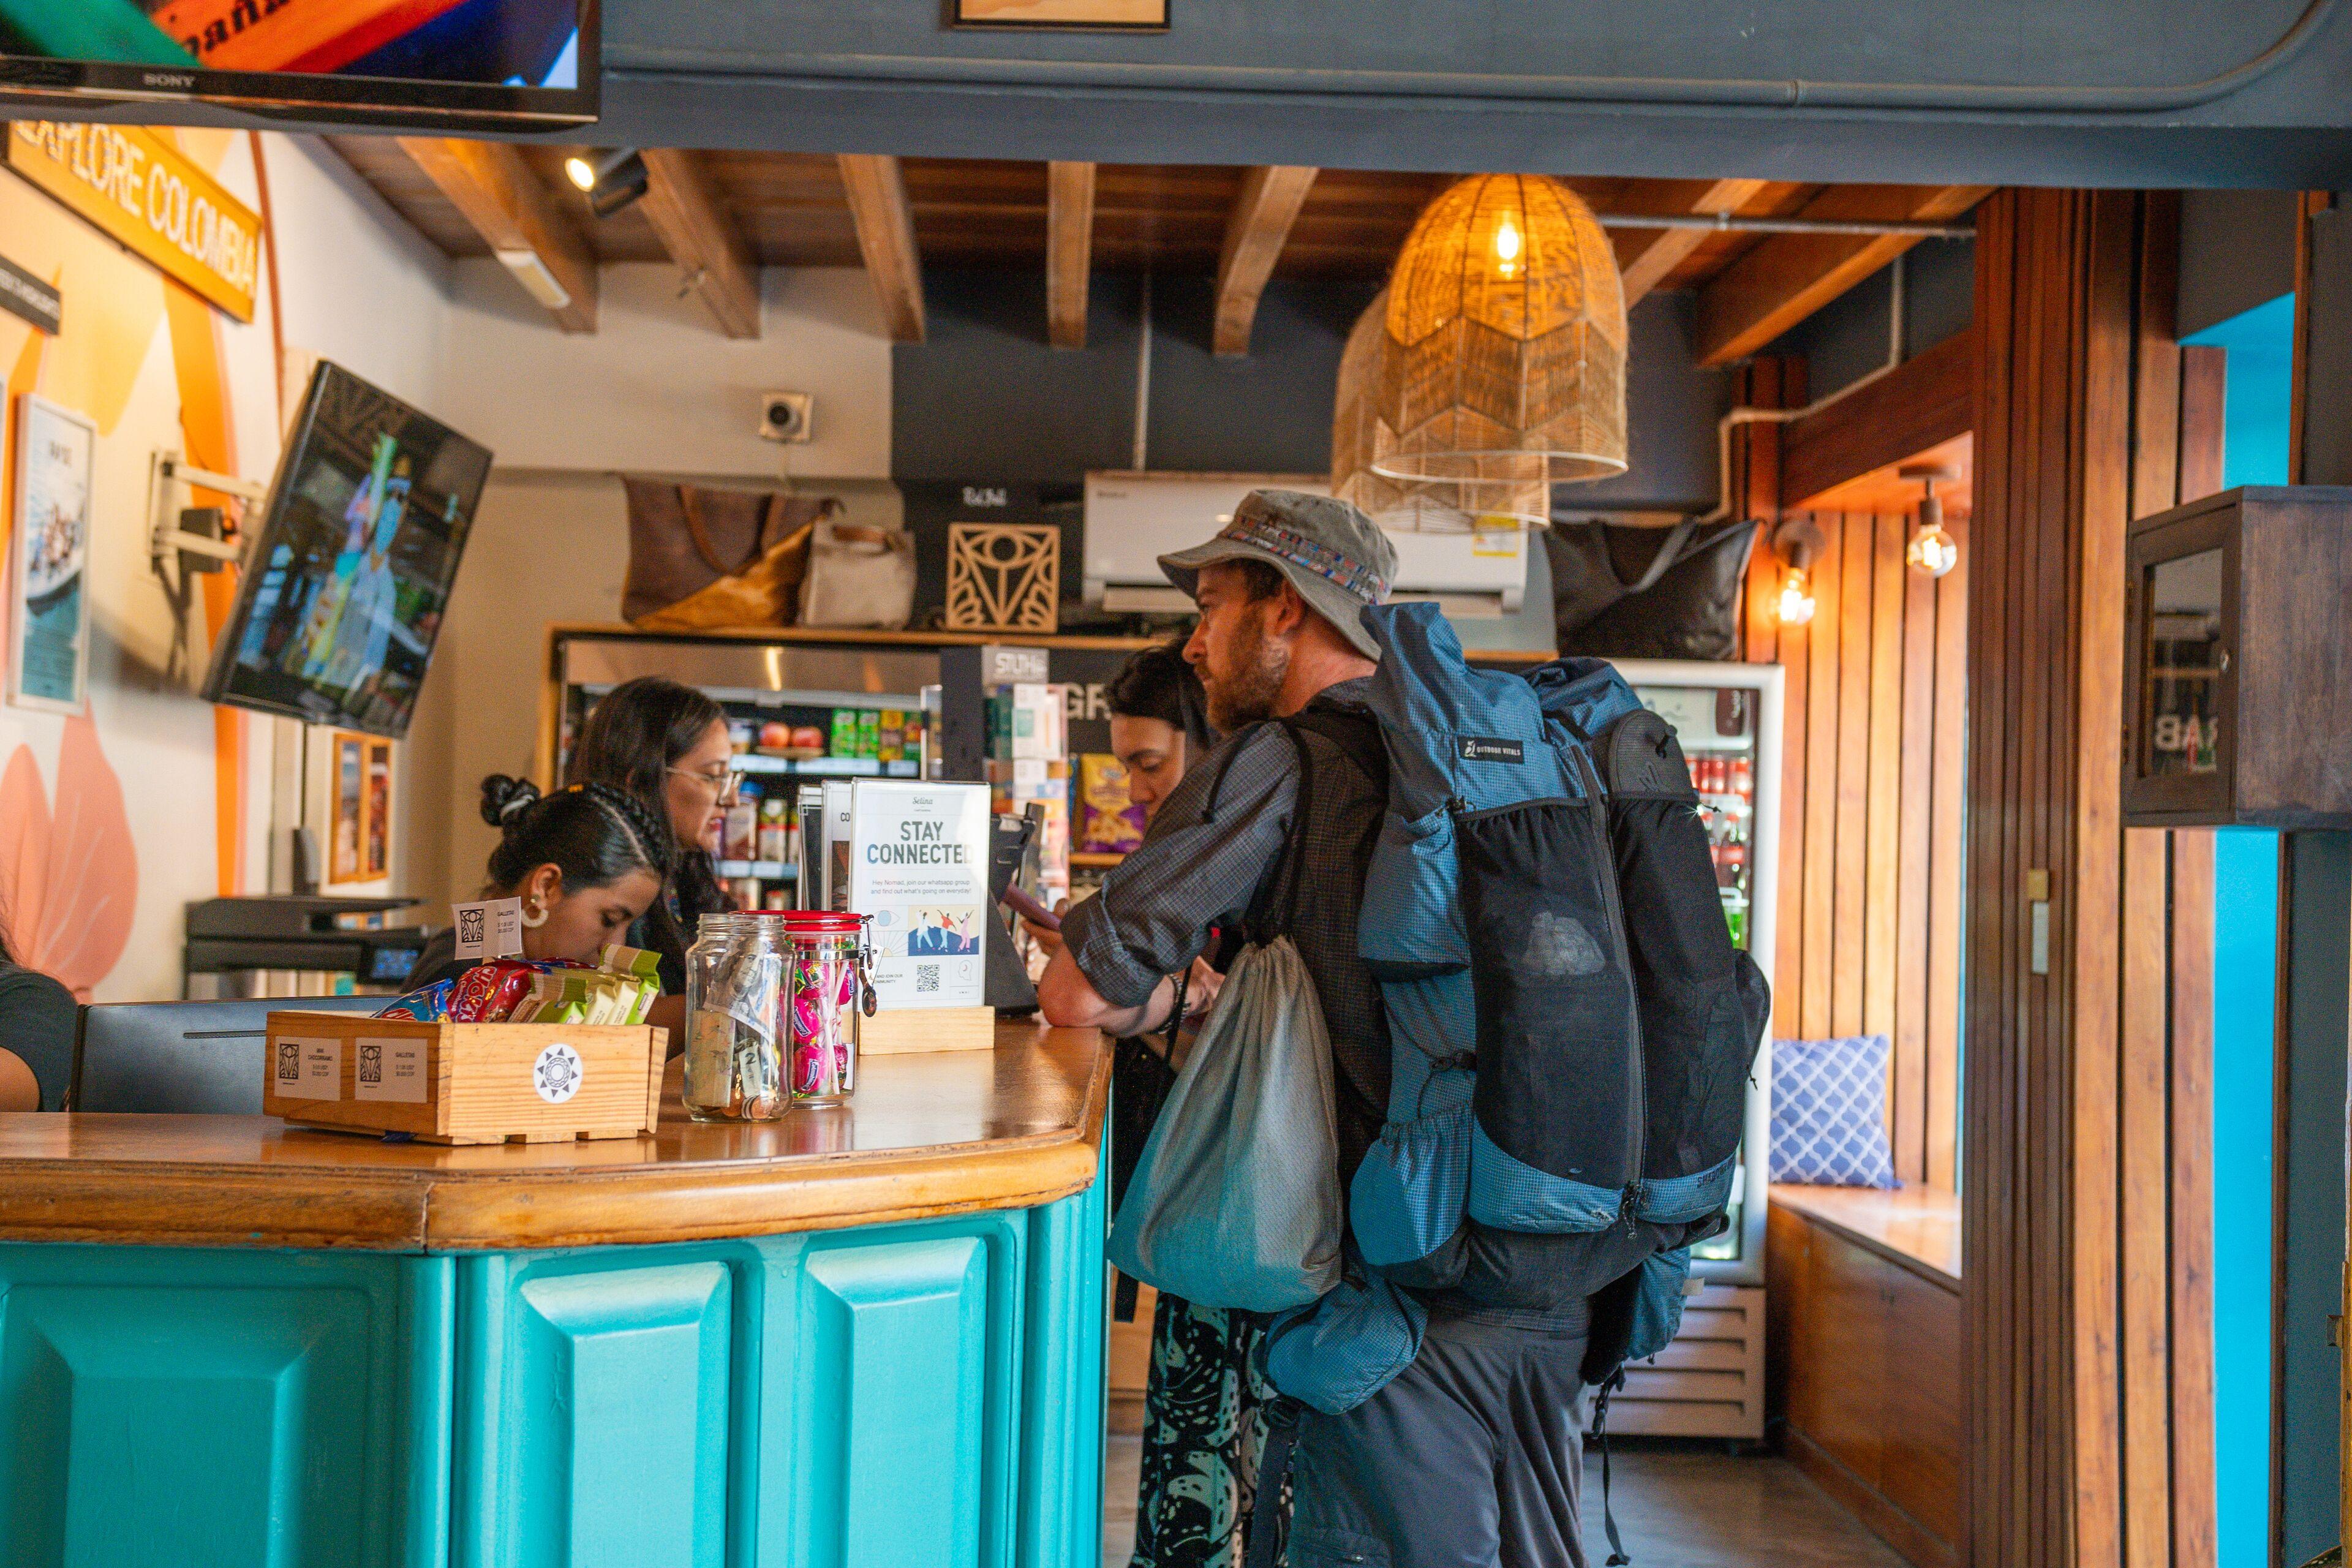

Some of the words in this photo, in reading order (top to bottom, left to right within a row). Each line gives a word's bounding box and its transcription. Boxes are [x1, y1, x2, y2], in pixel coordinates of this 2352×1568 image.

[143, 72, 196, 88] SONY
[1502, 747, 1521, 756] VITALS
[912, 796, 933, 805] Selina
[900, 820, 944, 842] STAY
[745, 1052, 756, 1065] 2
